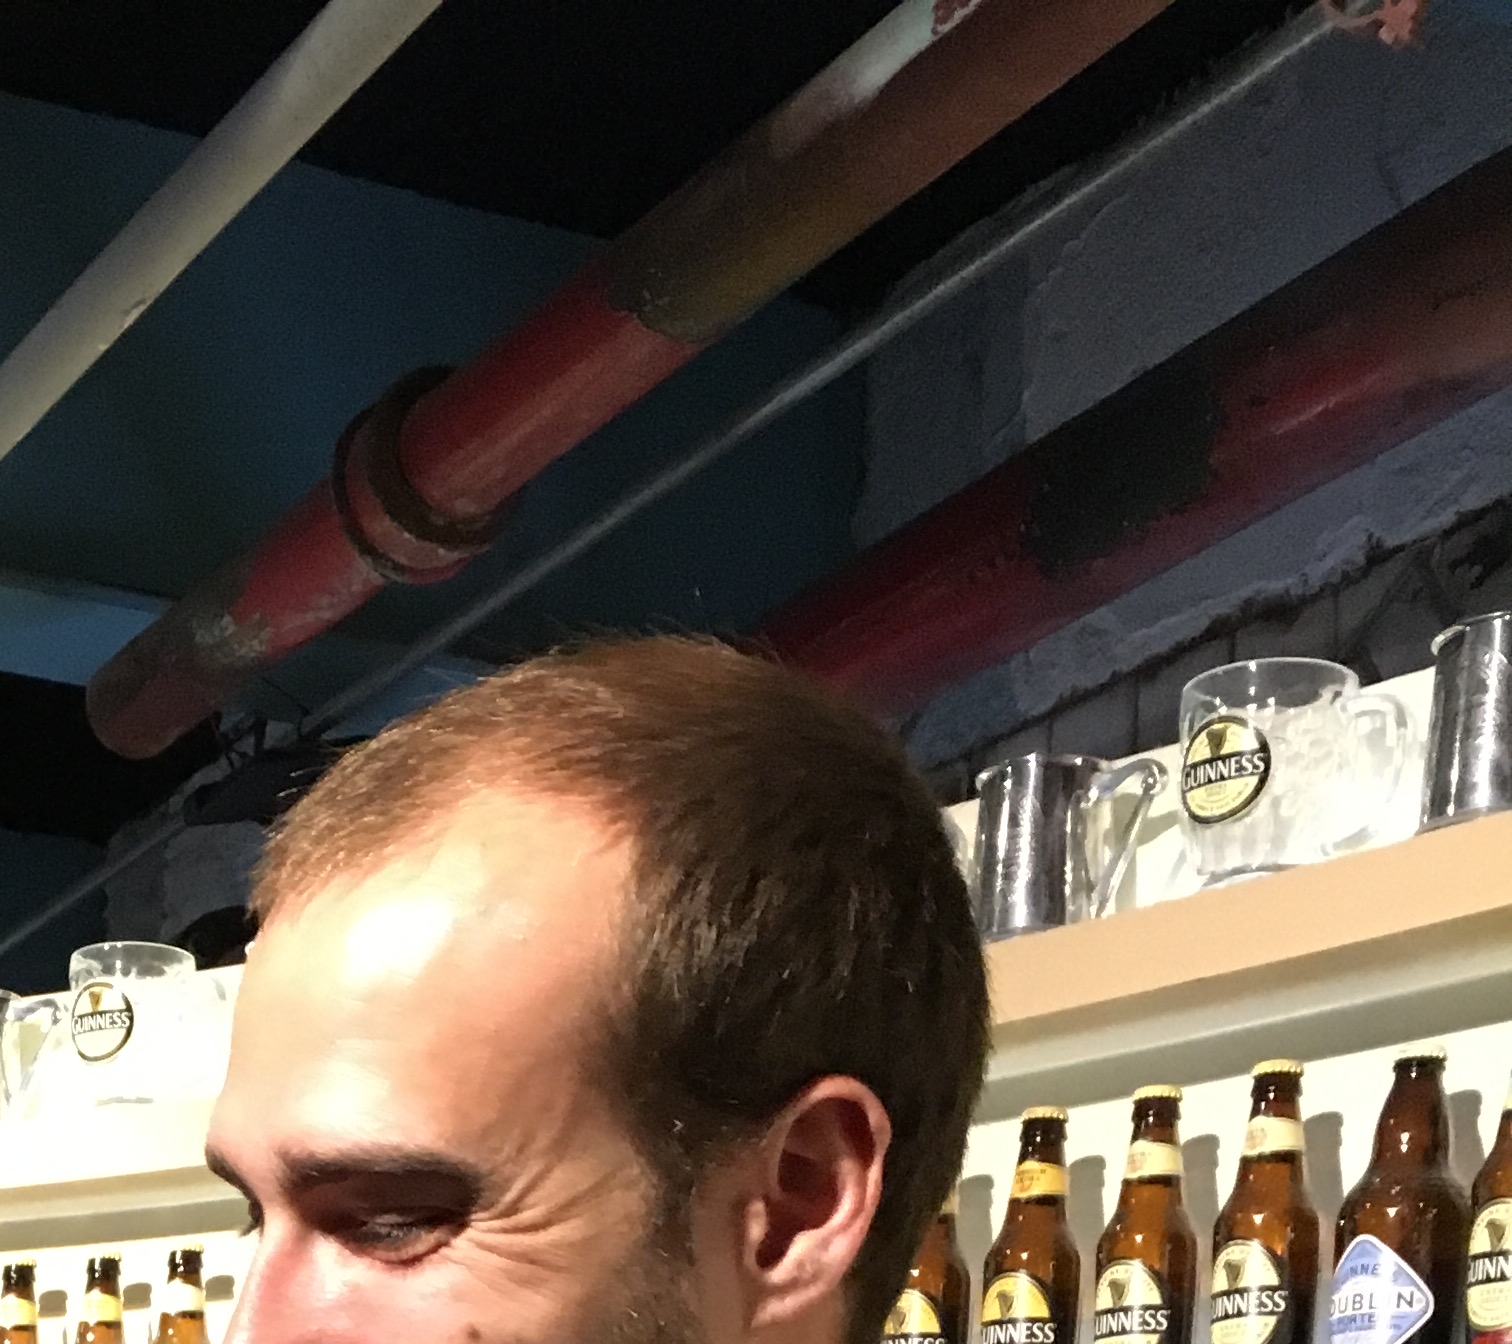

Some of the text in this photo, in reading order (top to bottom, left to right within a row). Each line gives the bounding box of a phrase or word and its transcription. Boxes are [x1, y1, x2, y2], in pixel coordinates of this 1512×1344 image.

[1183, 753, 1265, 790] GUINNESS
[72, 1012, 131, 1034] GUINNESS
[1467, 1256, 1512, 1284] UINN
[1213, 1290, 1286, 1318] UINNESS
[1330, 1291, 1414, 1315] UBLN
[1094, 1310, 1169, 1336] UINNESS
